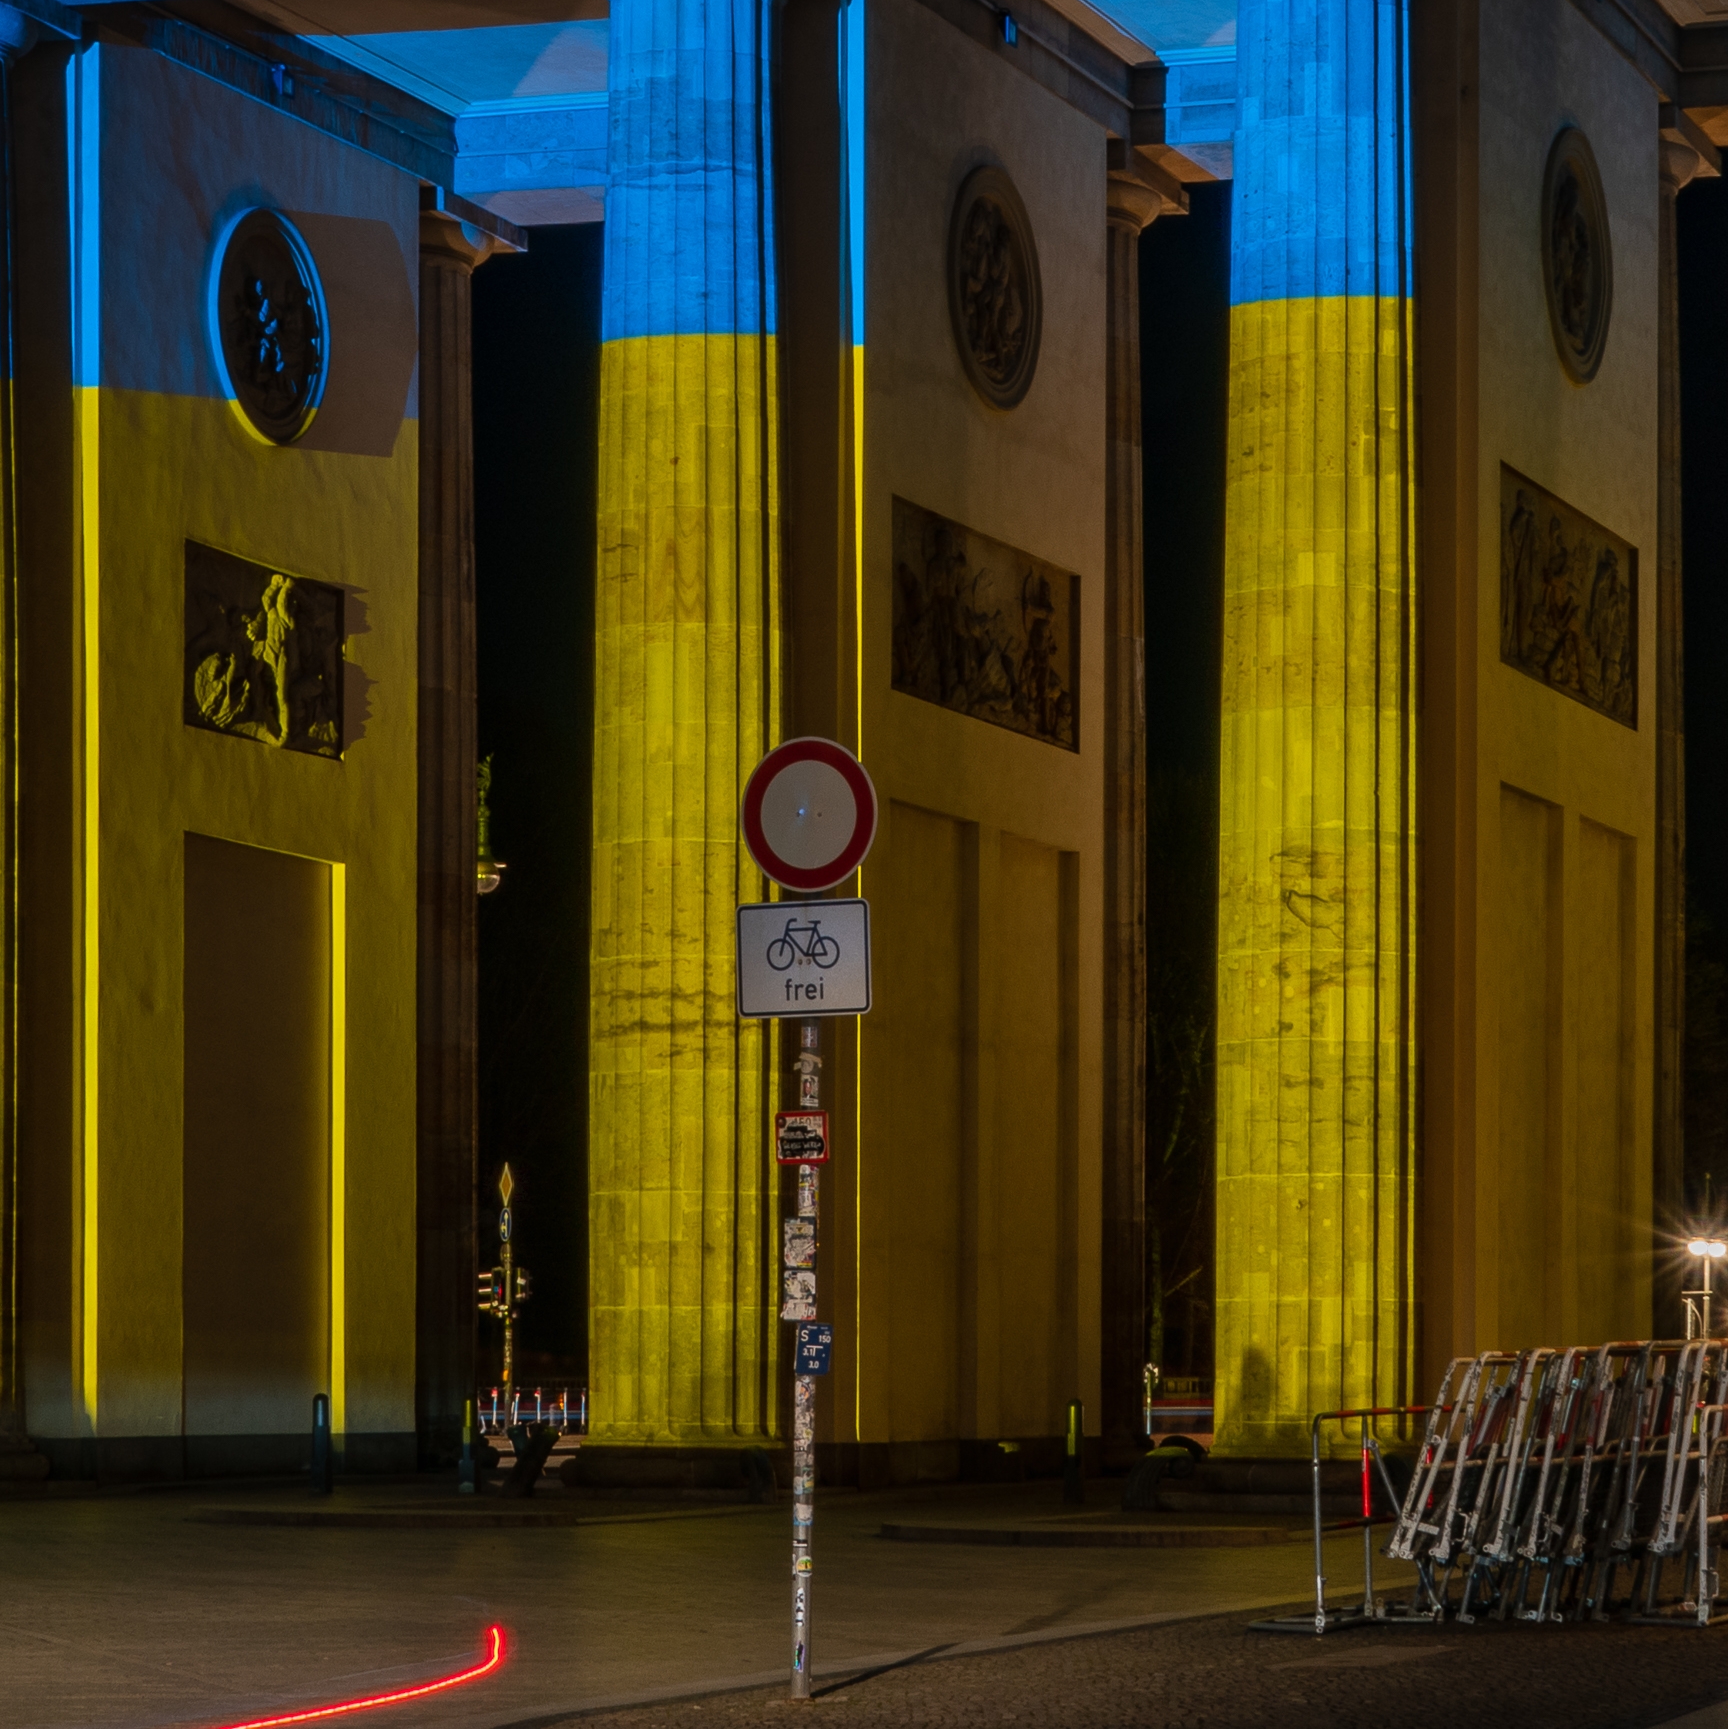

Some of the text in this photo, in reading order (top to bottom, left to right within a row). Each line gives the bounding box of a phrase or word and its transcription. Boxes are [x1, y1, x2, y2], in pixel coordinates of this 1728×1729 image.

[784, 976, 824, 1001] frei
[801, 1330, 809, 1341] S
[819, 1335, 831, 1343] 150
[808, 1360, 819, 1369] 3.0
